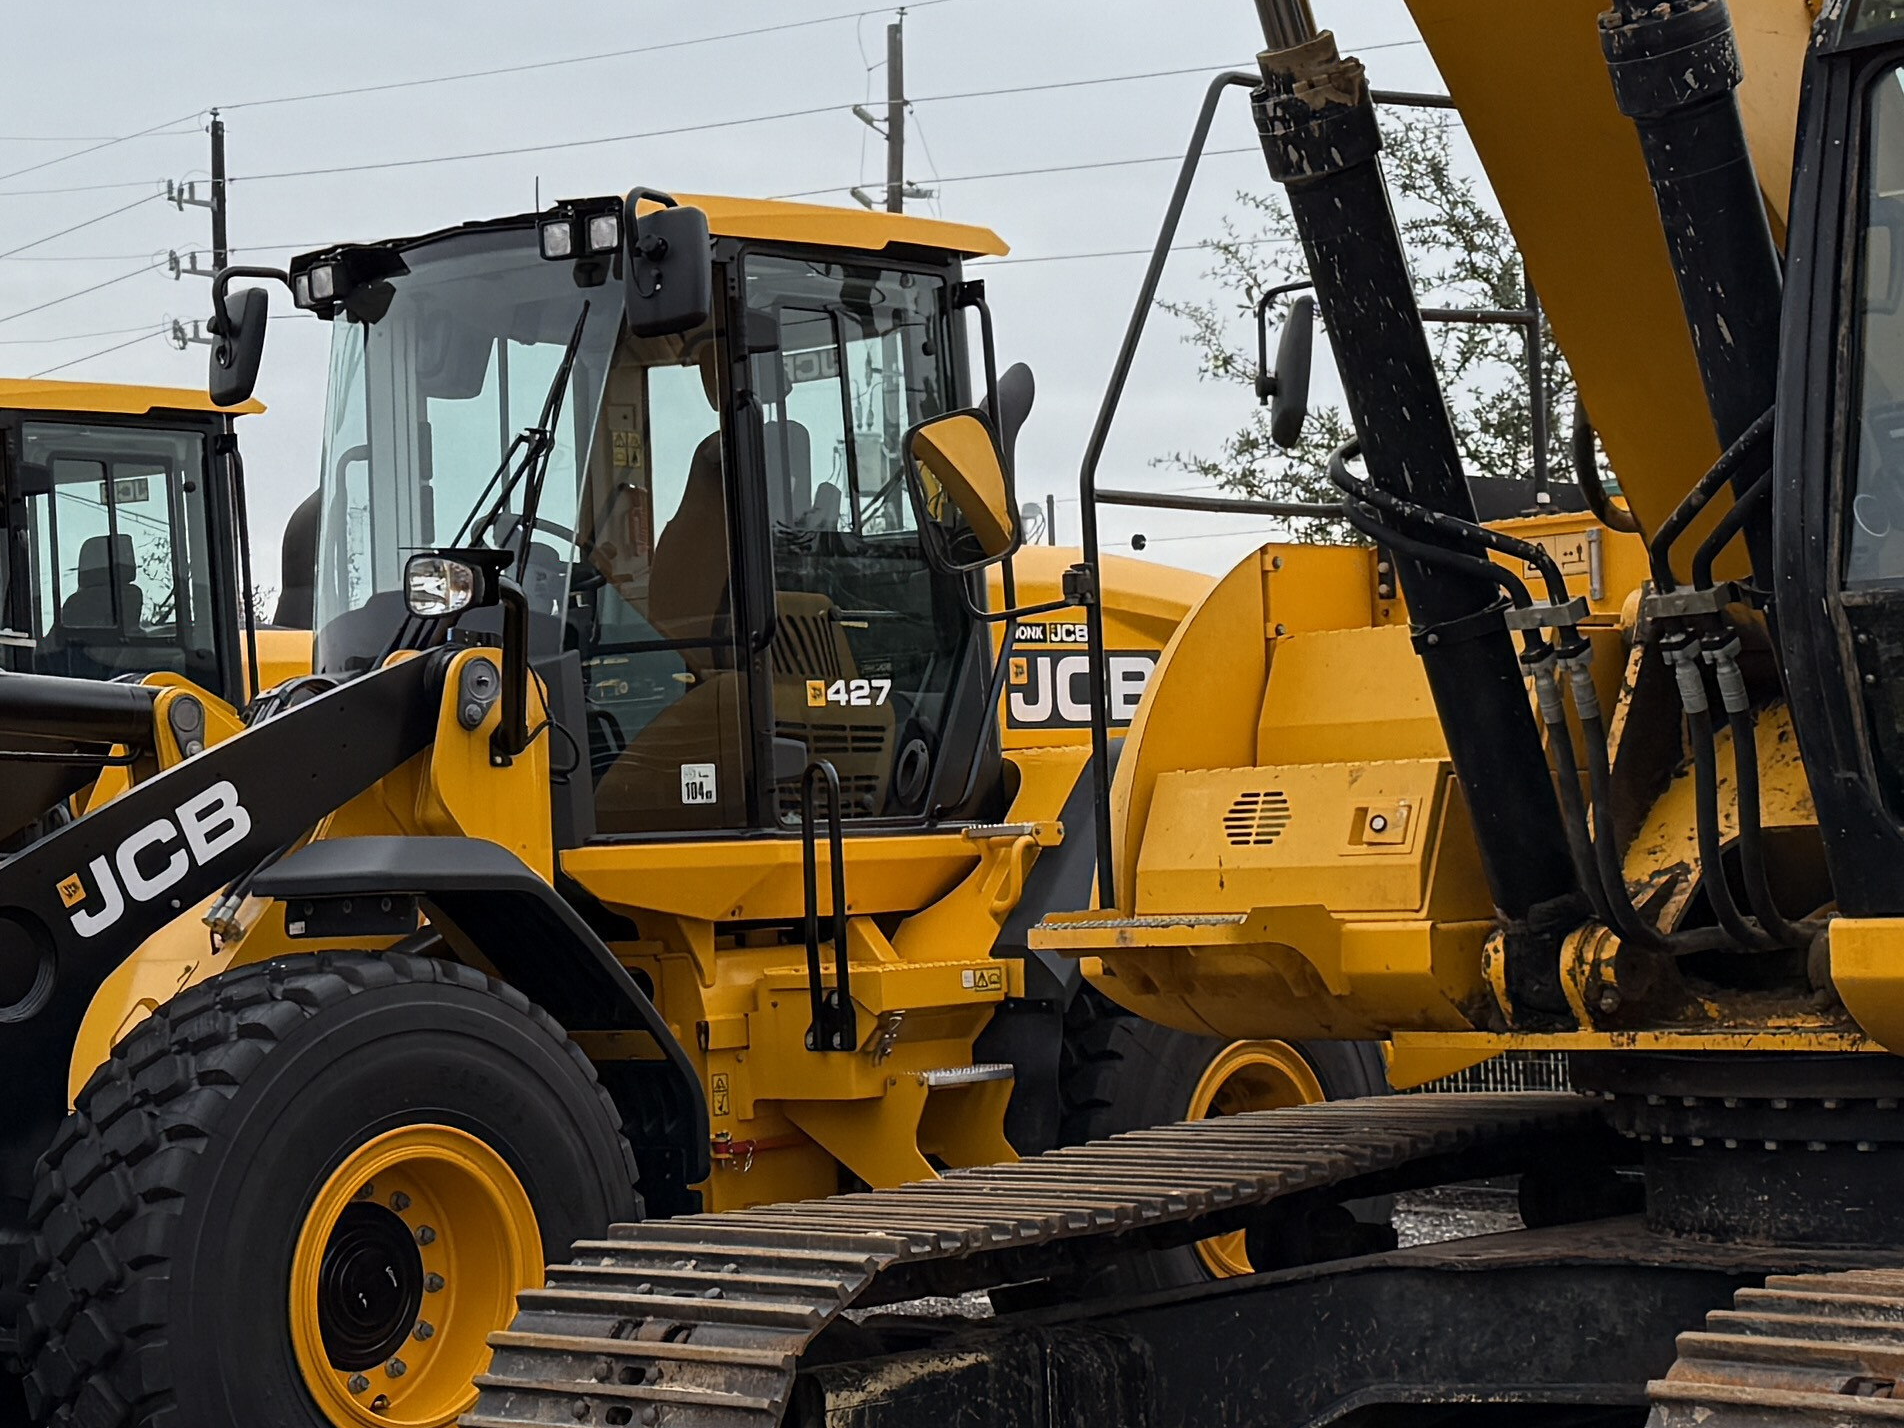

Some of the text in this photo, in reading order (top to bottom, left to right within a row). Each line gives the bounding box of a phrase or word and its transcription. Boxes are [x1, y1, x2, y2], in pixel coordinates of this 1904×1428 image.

[1050, 624, 1088, 642] JCB
[827, 679, 892, 706] 427
[1010, 656, 1156, 722] JCB
[70, 780, 252, 938] JCB
